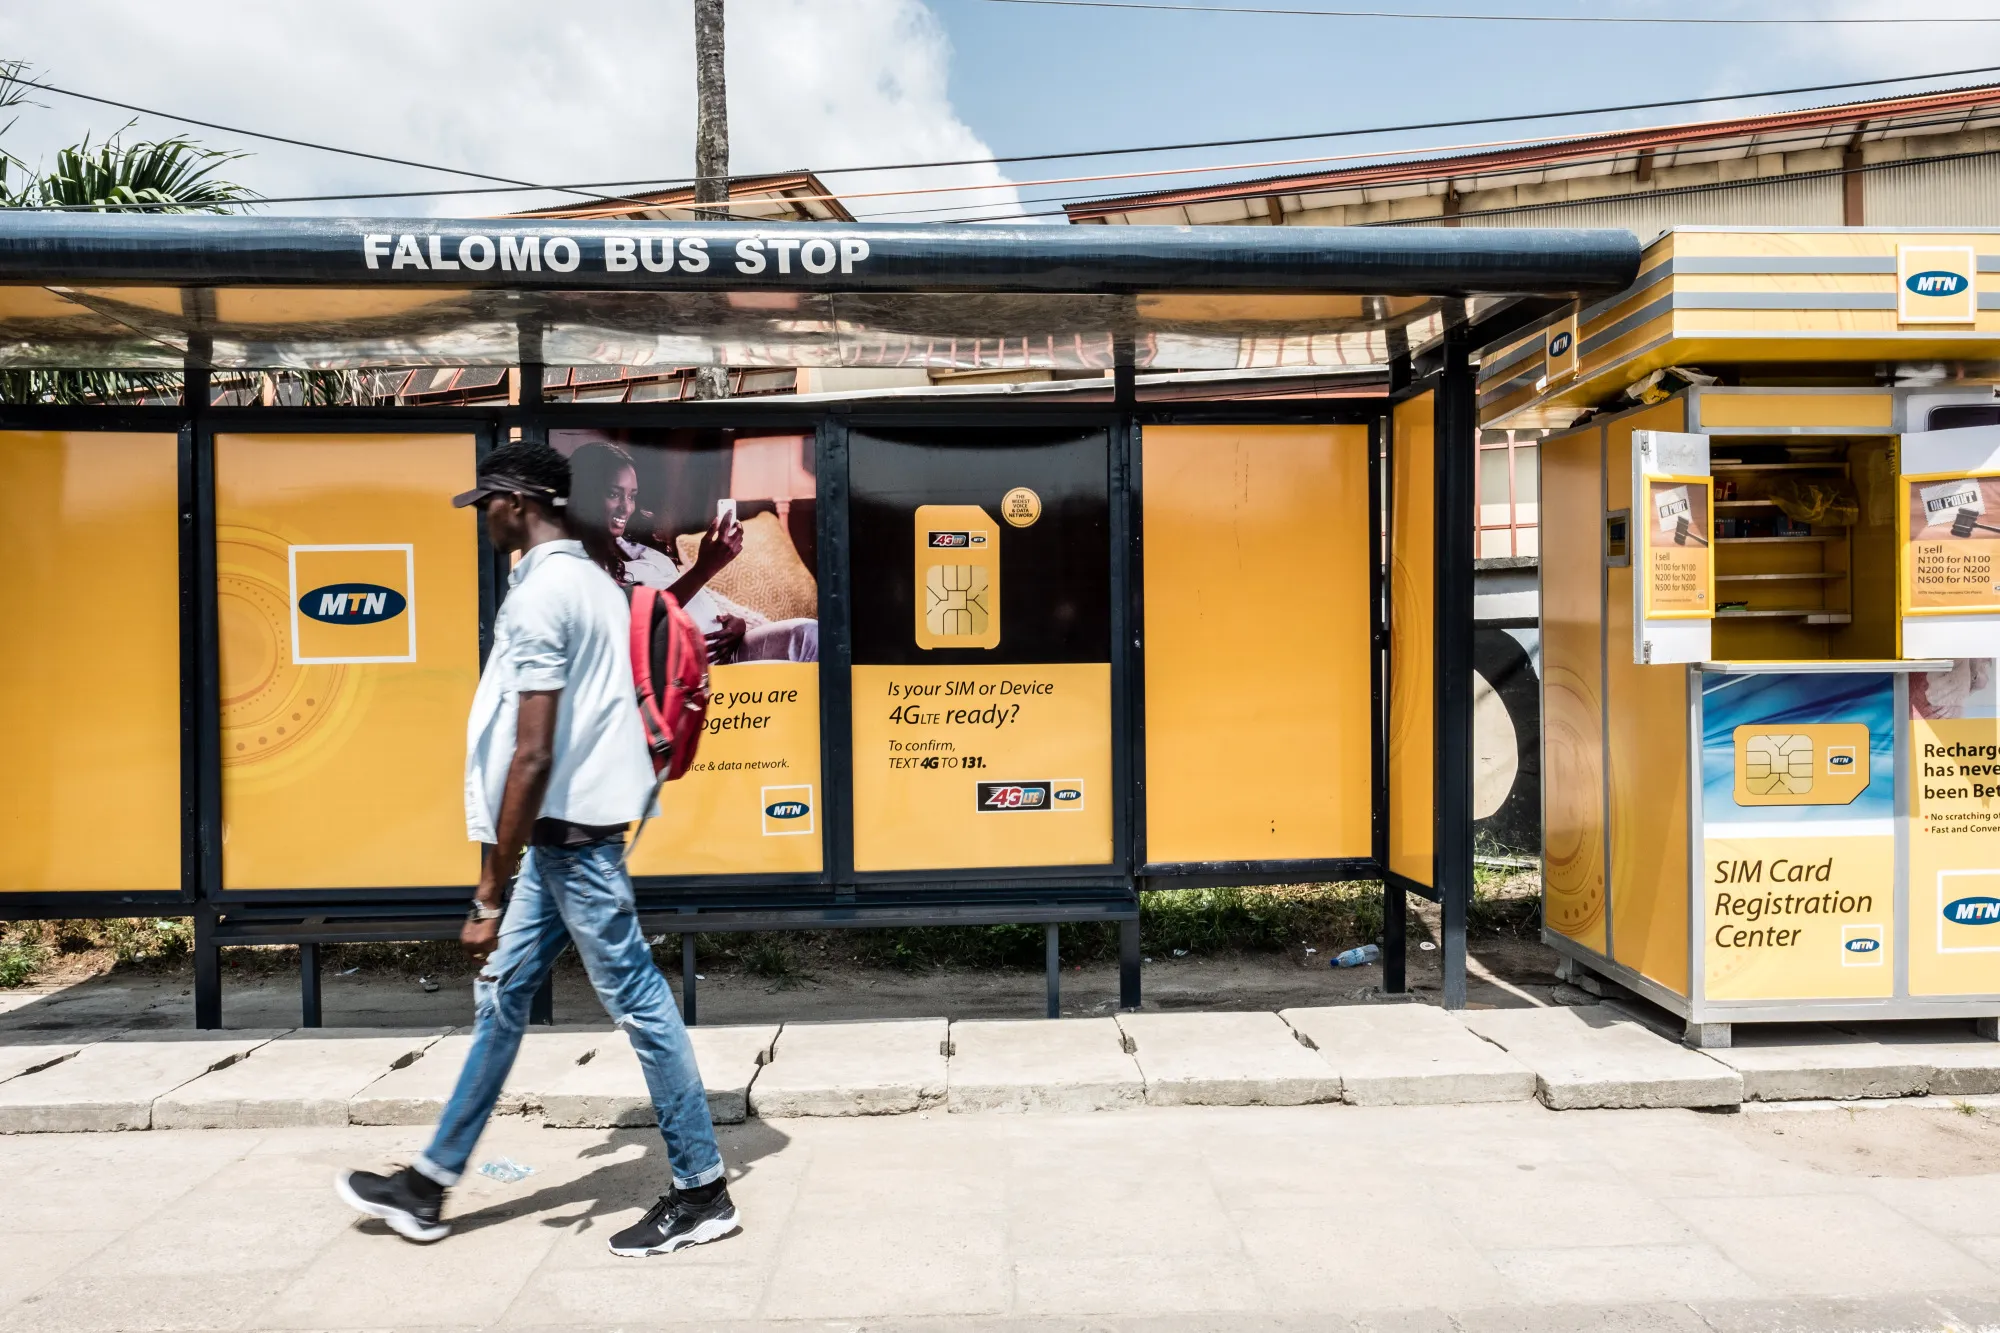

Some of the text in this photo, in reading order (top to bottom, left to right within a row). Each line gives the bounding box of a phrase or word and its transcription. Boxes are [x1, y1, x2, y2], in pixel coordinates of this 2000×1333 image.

[363, 234, 870, 275] FALOMO BUS STOP
[1917, 276, 1958, 291] MTN
[1552, 334, 1569, 354] MTN
[1659, 552, 1670, 560] sell
[1924, 545, 1943, 554] sell
[1655, 562, 1697, 571] N100 for N100
[1918, 555, 1991, 564] N100 for N100
[1917, 565, 1991, 574] N200 for N200
[1655, 573, 1697, 581] N200 for N200
[1917, 576, 1944, 584] N500
[1963, 575, 1990, 583] N500
[1655, 583, 1697, 591] N500 for N500
[318, 592, 387, 616] MTN
[887, 680, 1054, 700] Is your SIM or Device
[706, 689, 798, 709] re you are
[700, 712, 771, 734] ogether
[945, 703, 1020, 729] ready?
[888, 739, 956, 752] To confirm,
[1924, 742, 2000, 761] Recharg
[707, 761, 716, 771] &
[717, 760, 742, 771] data
[744, 758, 790, 770] network.
[888, 756, 987, 769] TEXT 4G TO 131.
[1832, 756, 1850, 764] MTN
[1924, 762, 2000, 777] has neve
[986, 786, 1077, 808] 4G LTE MTN
[1924, 784, 1968, 799] been
[773, 804, 802, 816] MTN
[1930, 812, 2000, 821] No scratching o
[1931, 825, 1949, 833] Fast
[1951, 825, 1968, 833] and
[1714, 857, 1833, 884] SIM Card
[1714, 890, 1873, 922] Registration
[1955, 902, 2000, 920] MTN
[1715, 924, 1802, 948] Center
[1850, 941, 1875, 950] MTN
